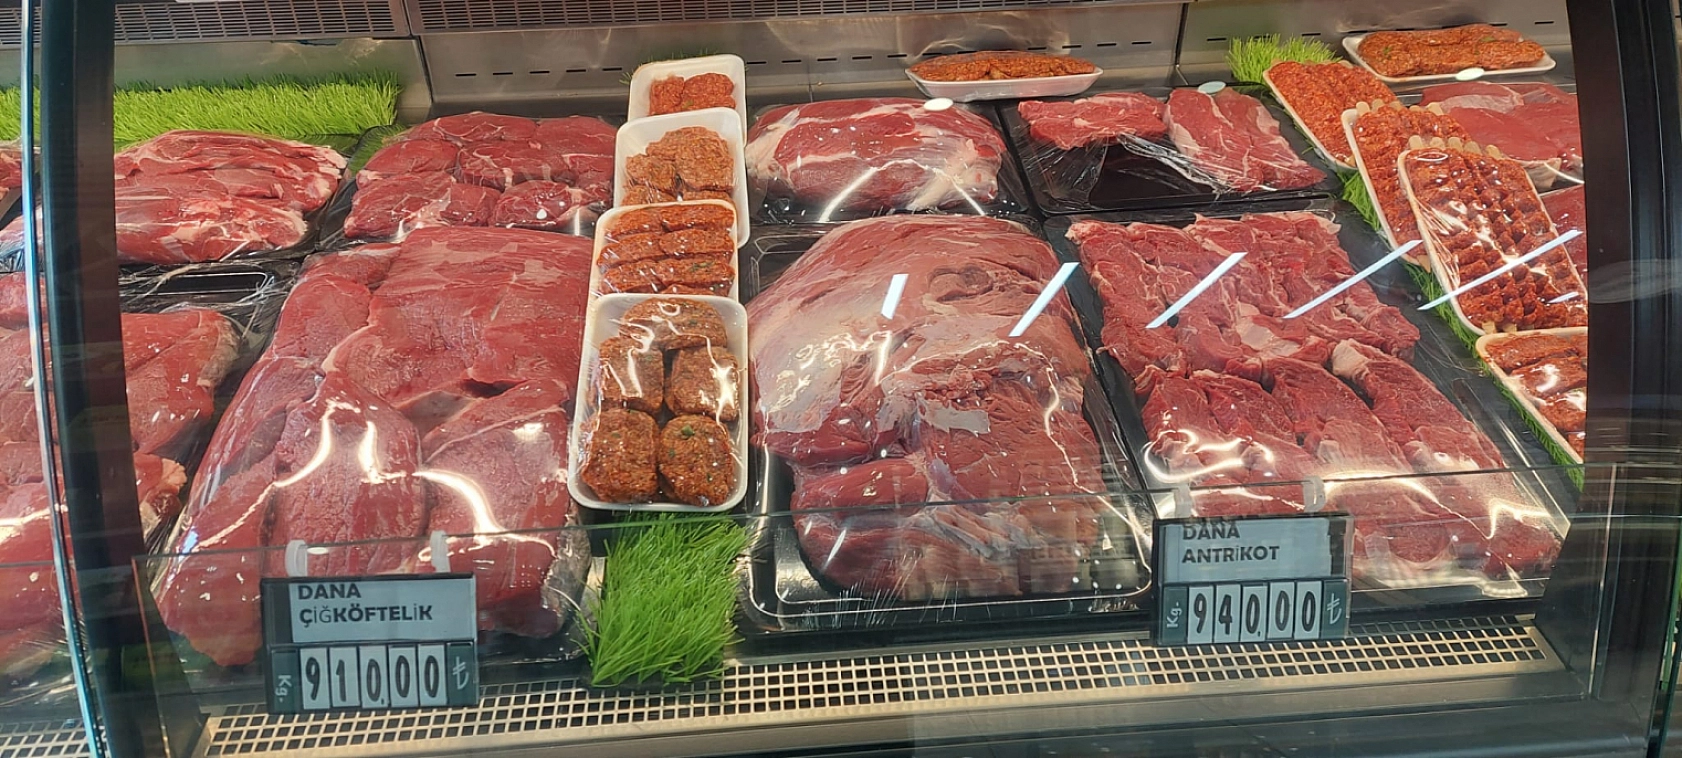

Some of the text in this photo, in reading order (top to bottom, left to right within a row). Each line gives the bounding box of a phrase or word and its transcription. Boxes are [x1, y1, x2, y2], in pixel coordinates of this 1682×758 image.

[1182, 522, 1240, 541] DANA
[1182, 546, 1280, 564] ANTRİKOT
[298, 583, 361, 600] DANA
